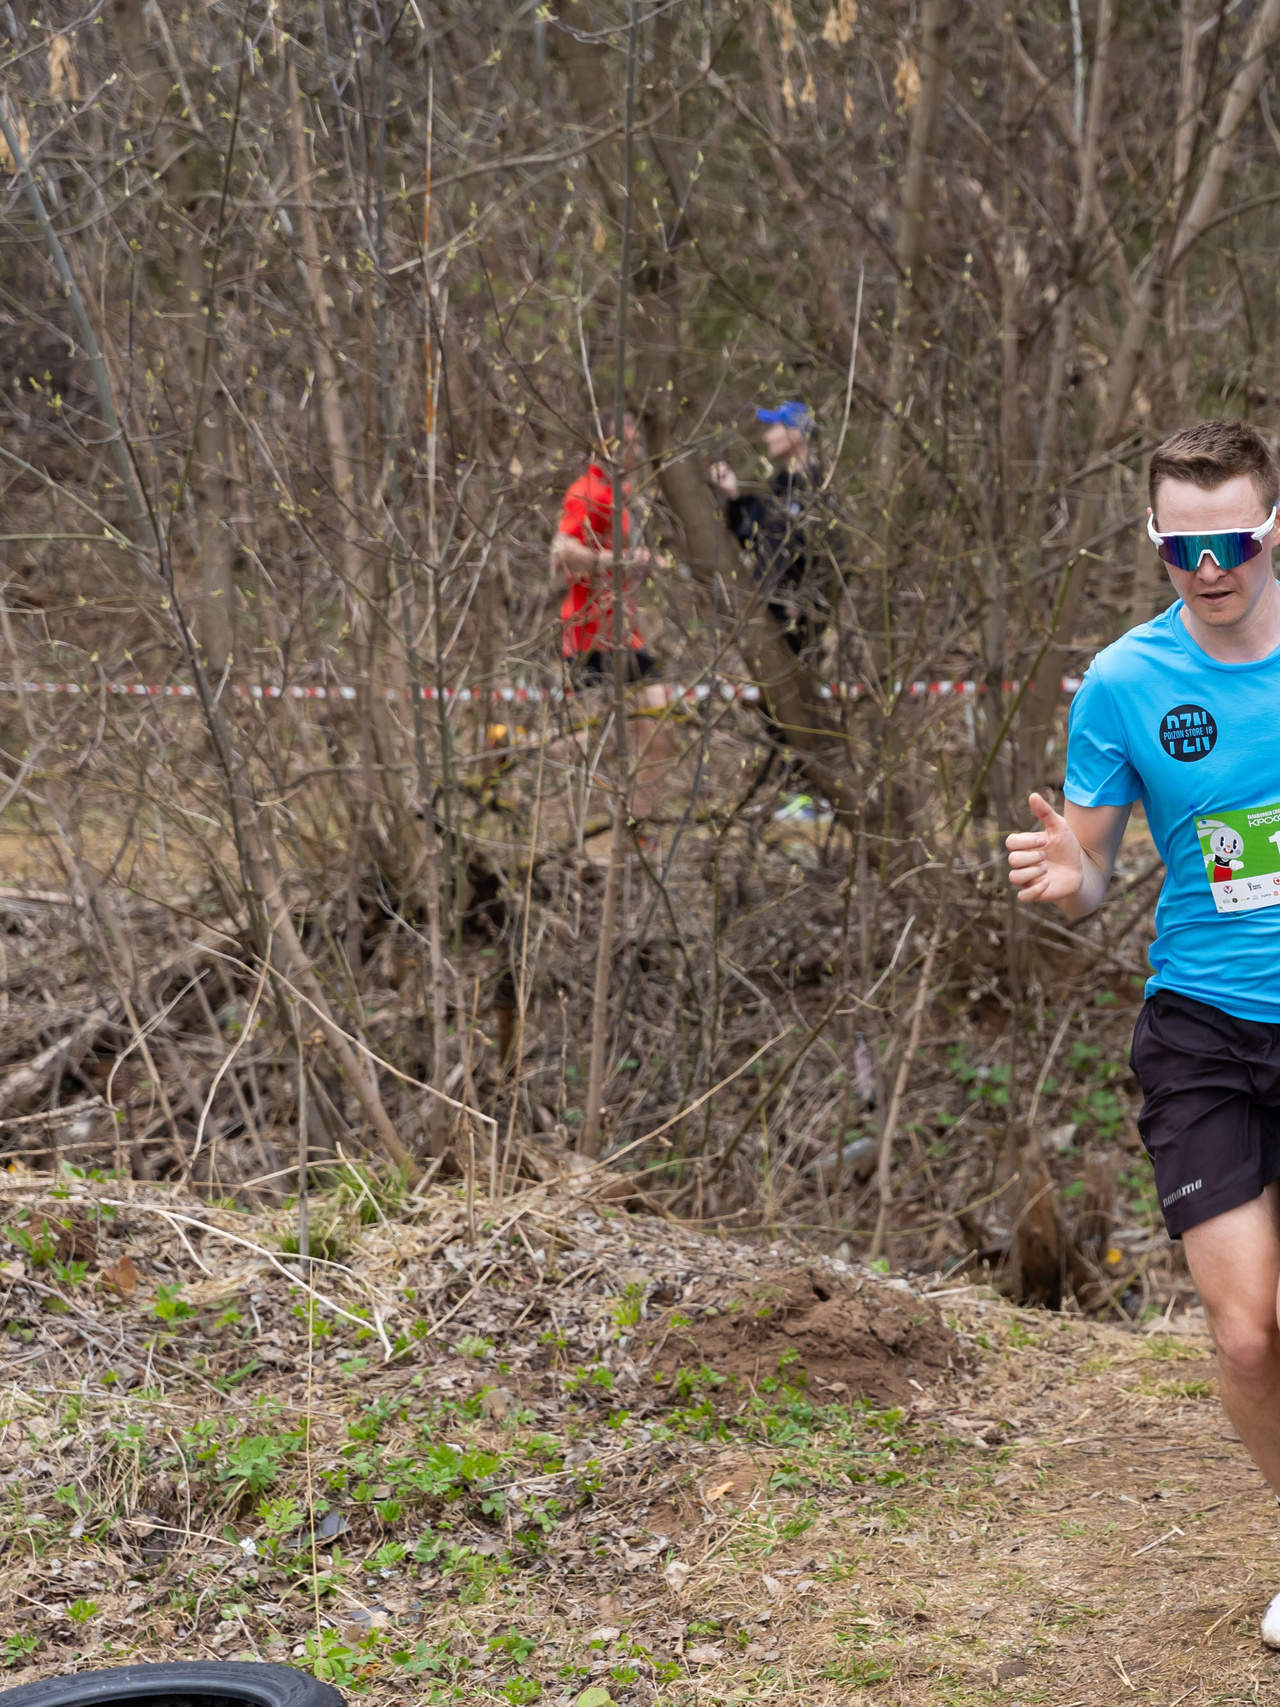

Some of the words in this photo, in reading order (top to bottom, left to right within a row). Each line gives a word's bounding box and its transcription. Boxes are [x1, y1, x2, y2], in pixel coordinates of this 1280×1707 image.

[1163, 730, 1184, 741] POIZON
[1185, 727, 1204, 738] STORE
[1205, 726, 1213, 735] 18
[1163, 1179, 1202, 1207] noname
